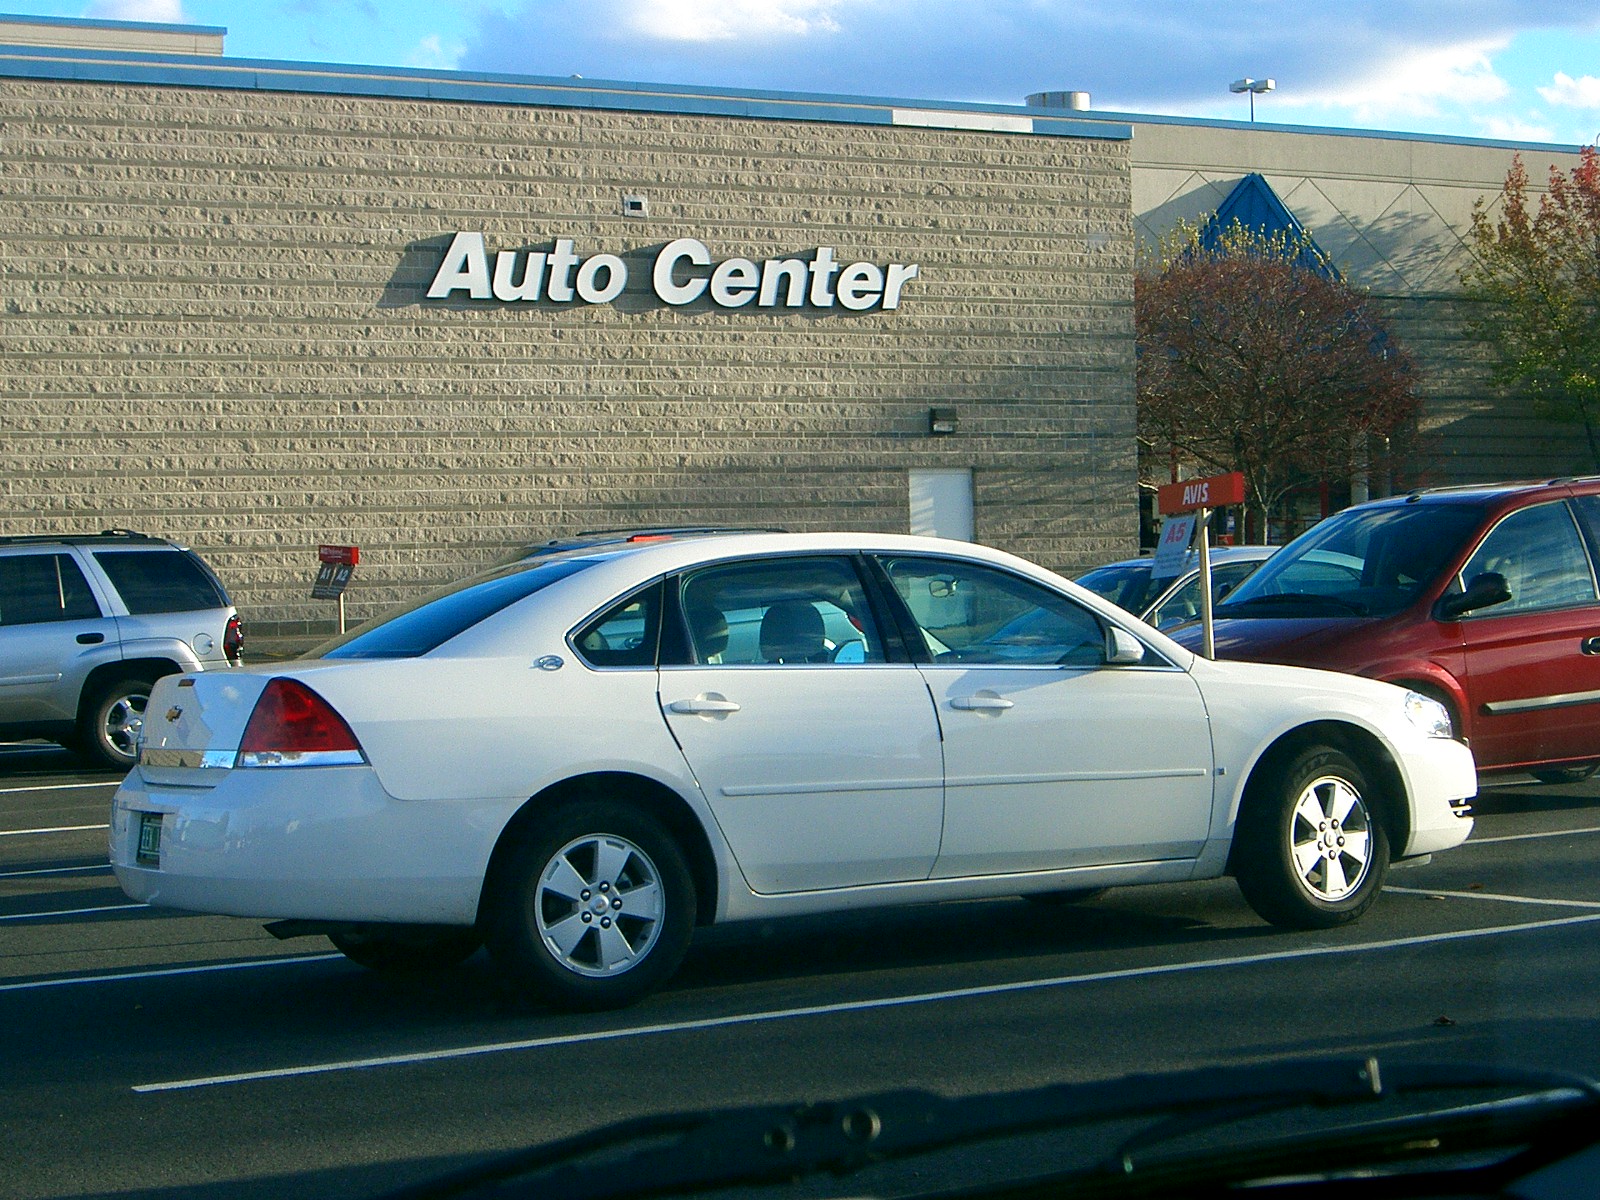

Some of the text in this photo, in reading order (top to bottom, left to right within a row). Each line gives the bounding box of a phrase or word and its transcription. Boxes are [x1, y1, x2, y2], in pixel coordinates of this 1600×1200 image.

[426, 231, 919, 310] Auto Center
[1182, 482, 1209, 506] AVIS
[1165, 521, 1187, 544] A5
[320, 567, 349, 582] A1 A2
